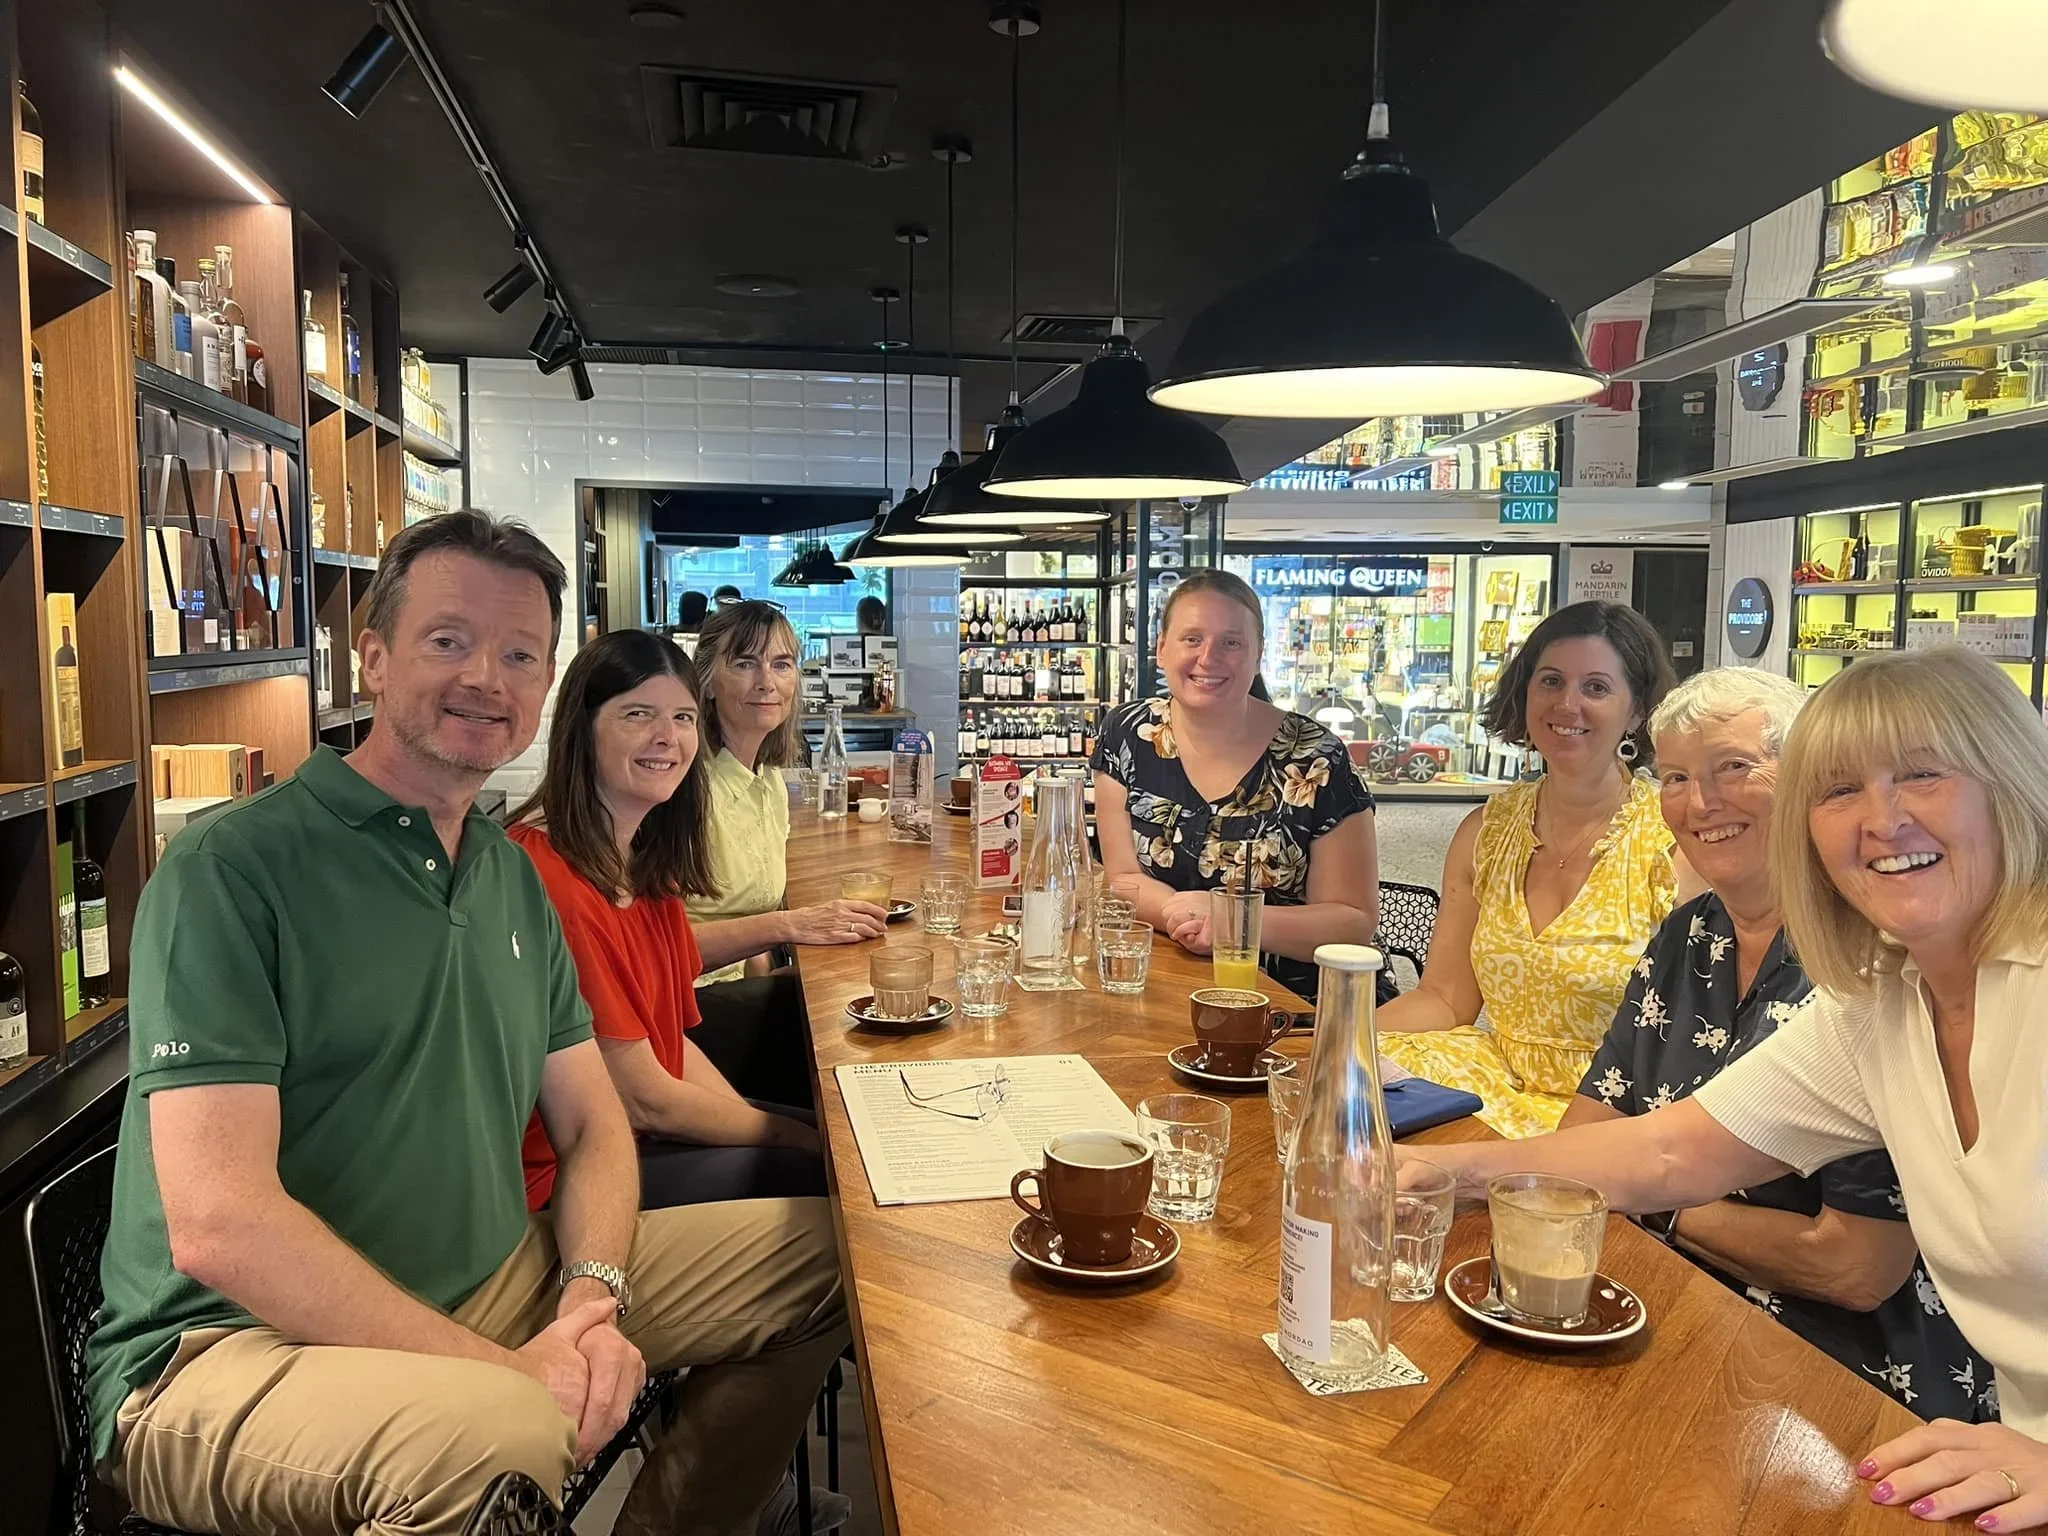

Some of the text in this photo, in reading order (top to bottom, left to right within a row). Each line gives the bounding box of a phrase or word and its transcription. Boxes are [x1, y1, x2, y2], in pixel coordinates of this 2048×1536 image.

[1512, 502, 1546, 520] EXIT
[1255, 566, 1423, 592] FLAMING QUEEN
[1575, 581, 1628, 590] MANDARIN
[1583, 590, 1620, 599] REPTILE
[151, 1040, 190, 1058] Polo
[1390, 1363, 1426, 1383] TEA
